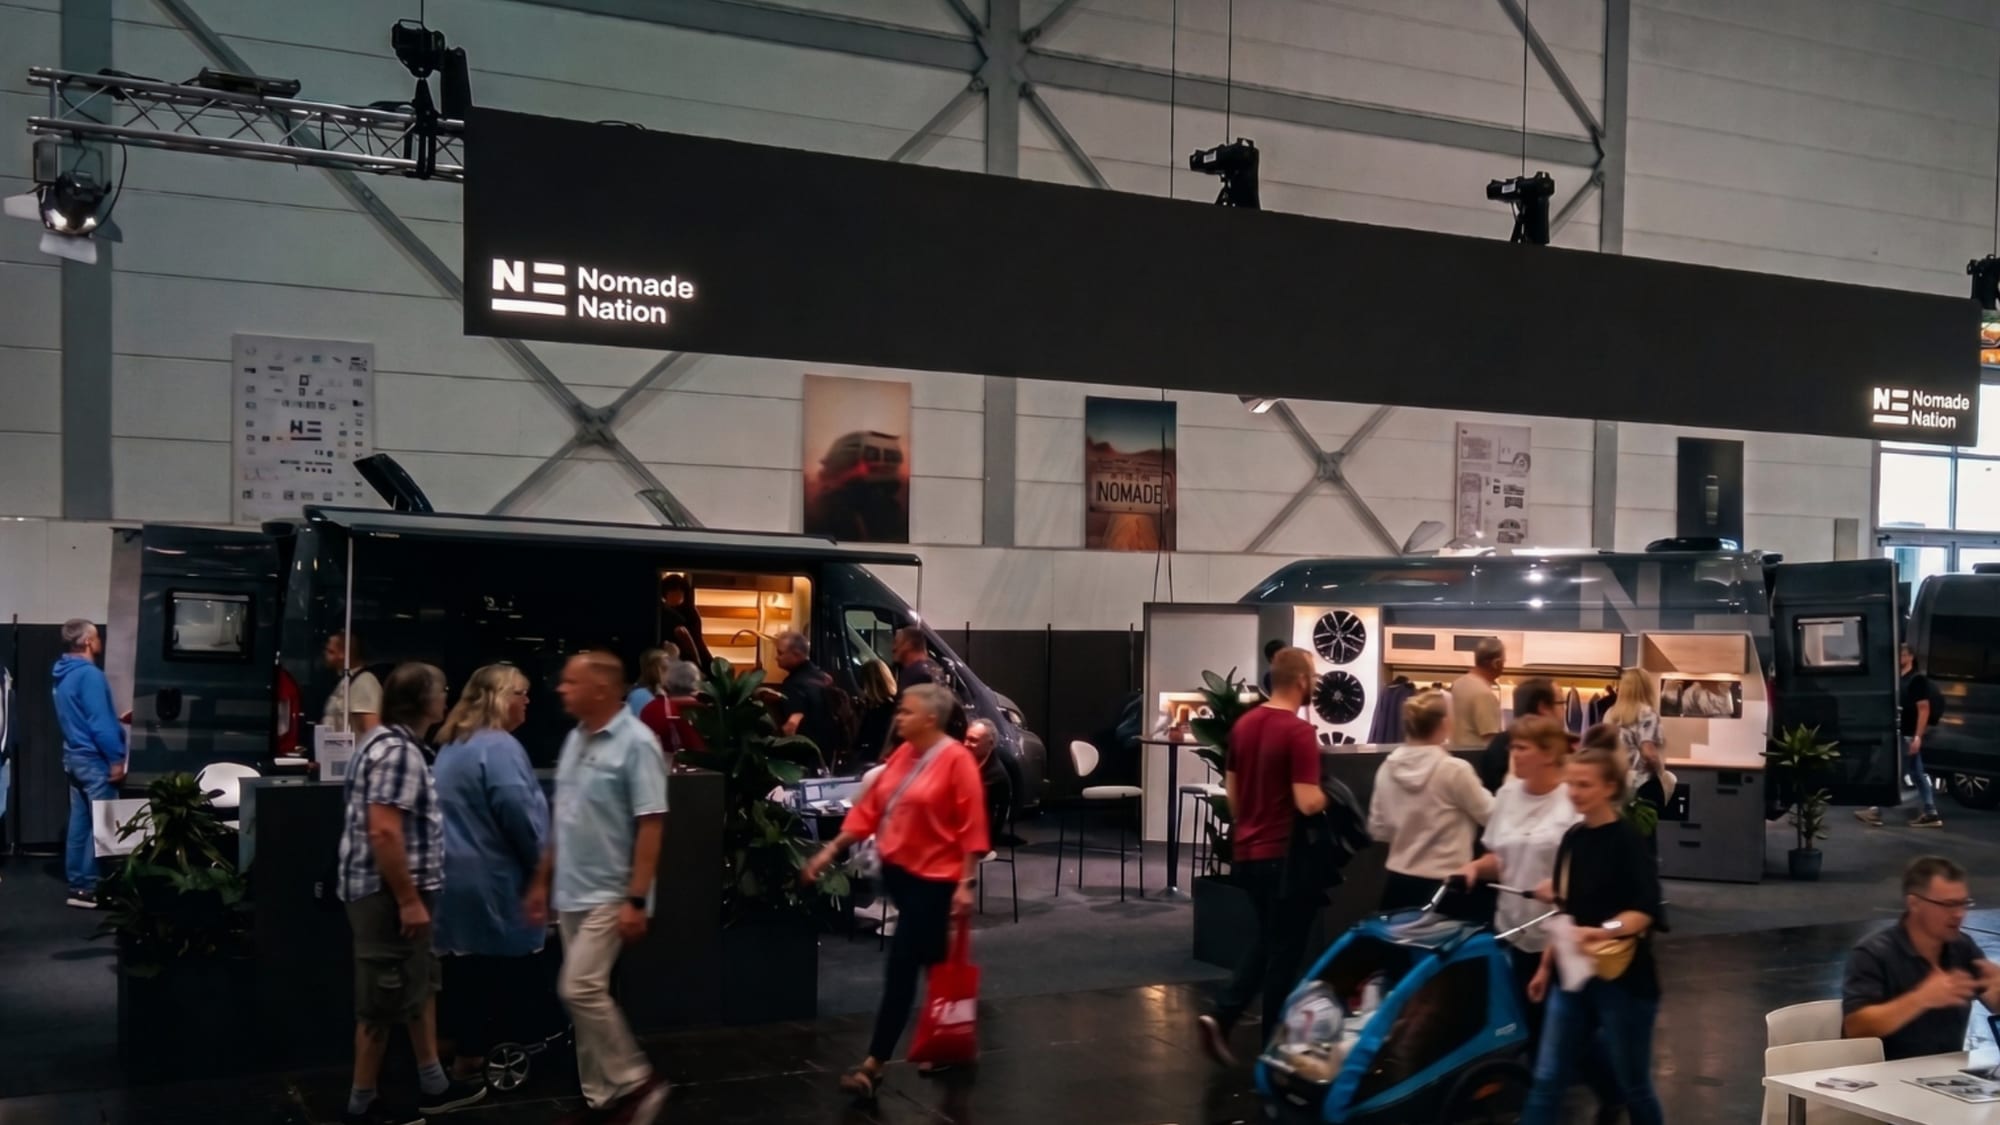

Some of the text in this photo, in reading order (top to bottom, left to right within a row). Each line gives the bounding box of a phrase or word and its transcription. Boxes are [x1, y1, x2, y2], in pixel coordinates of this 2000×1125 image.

[577, 266, 694, 299] Nomade
[577, 295, 667, 324] Nation
[1912, 390, 1970, 410] Nomade
[1911, 409, 1957, 429] Nation
[1097, 481, 1163, 505] NOMADE
